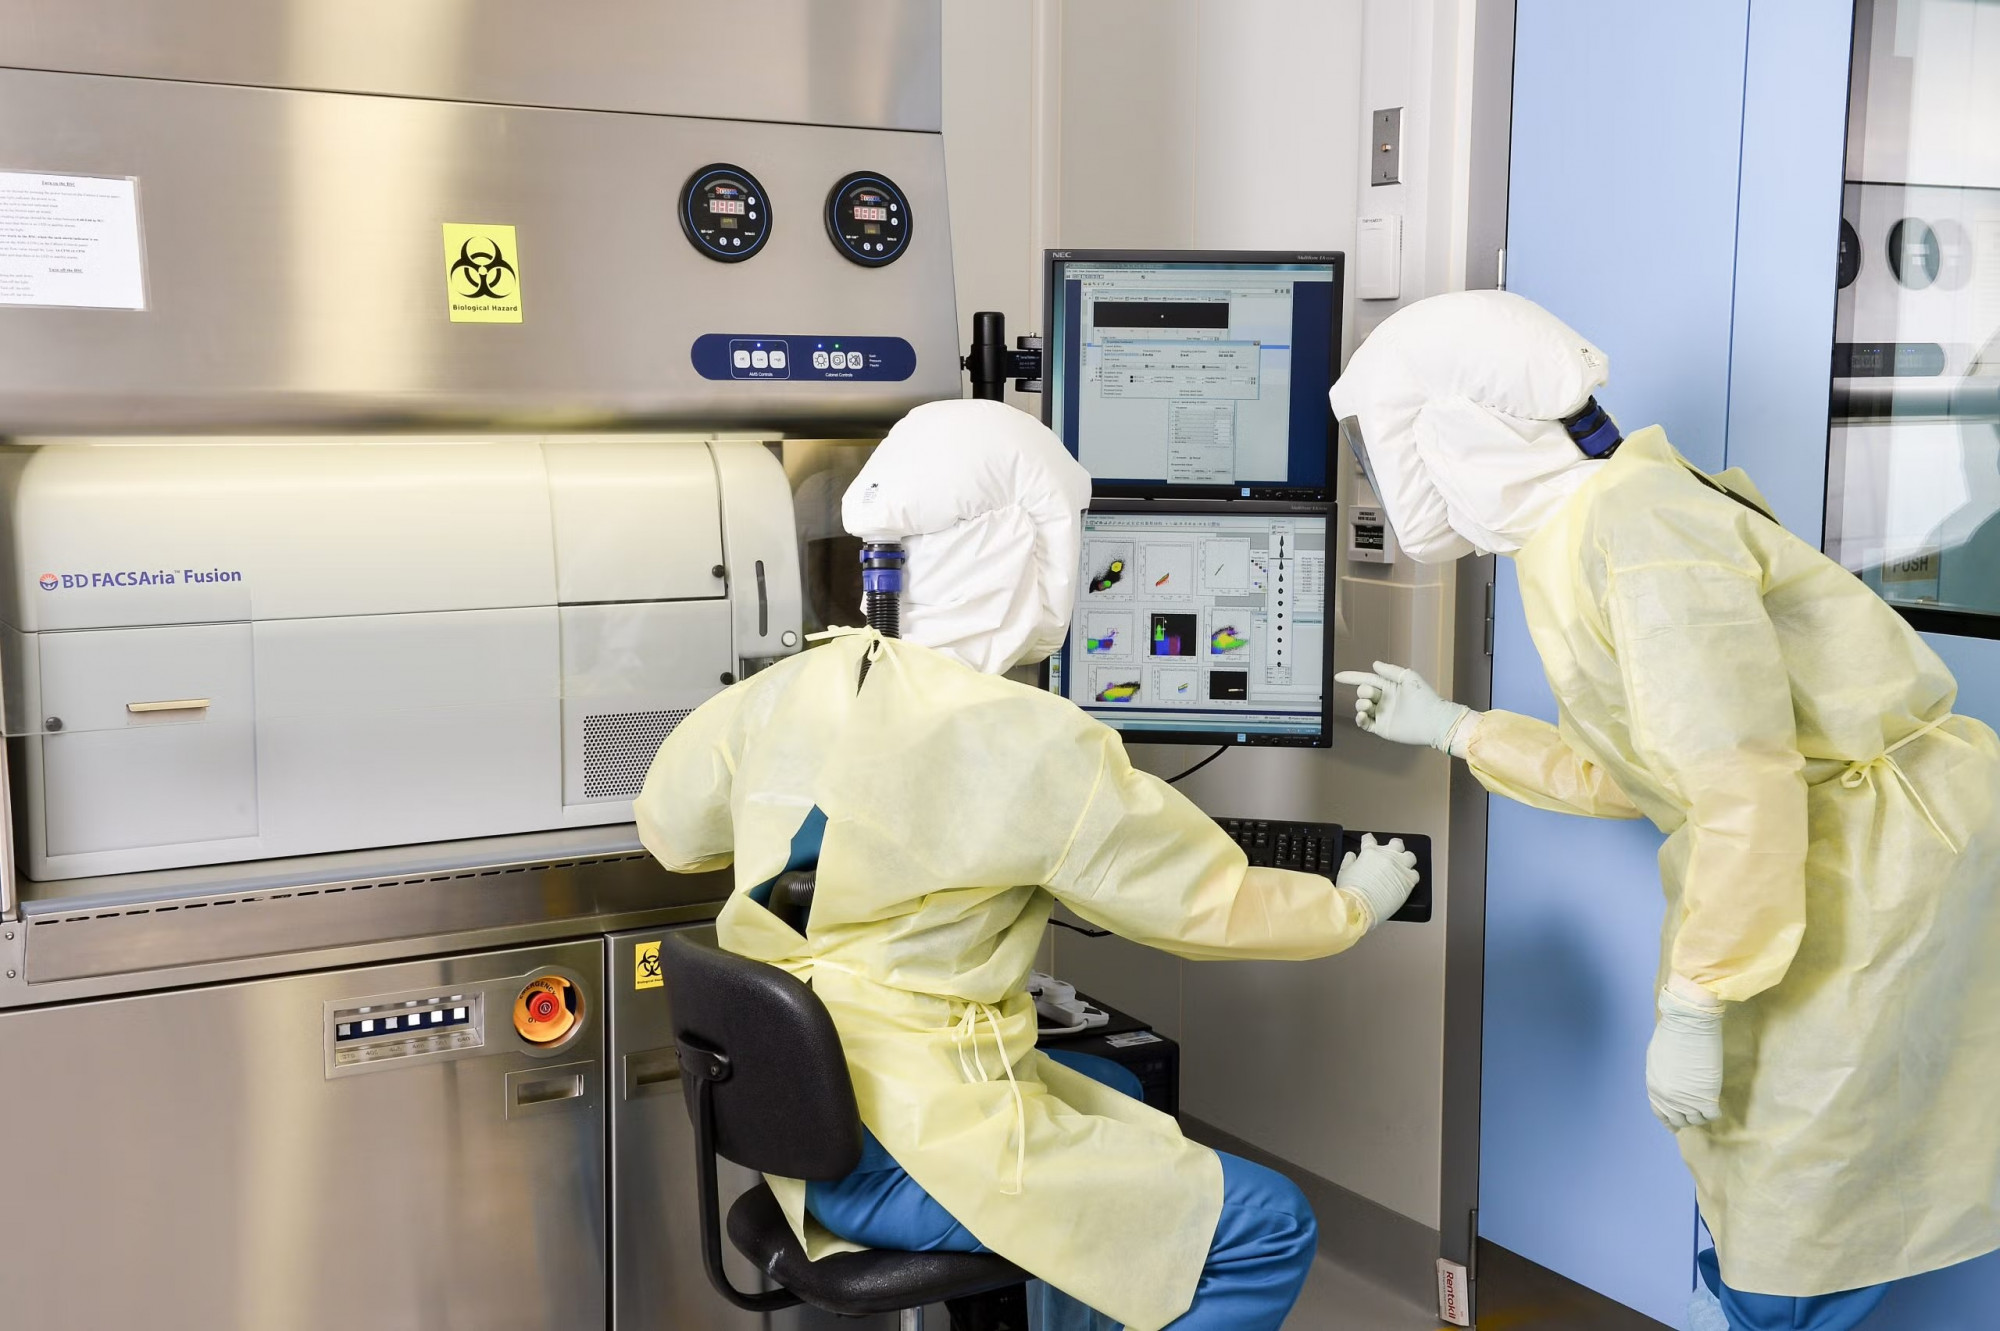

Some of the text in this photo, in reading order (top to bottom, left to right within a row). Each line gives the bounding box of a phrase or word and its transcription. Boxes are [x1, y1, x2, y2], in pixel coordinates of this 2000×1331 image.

[1893, 555, 1929, 572] PUSH
[61, 574, 88, 588] BD
[184, 568, 242, 584] Fusion
[519, 981, 556, 1000] EMERGENCY
[1446, 1271, 1456, 1319] Rentokil
